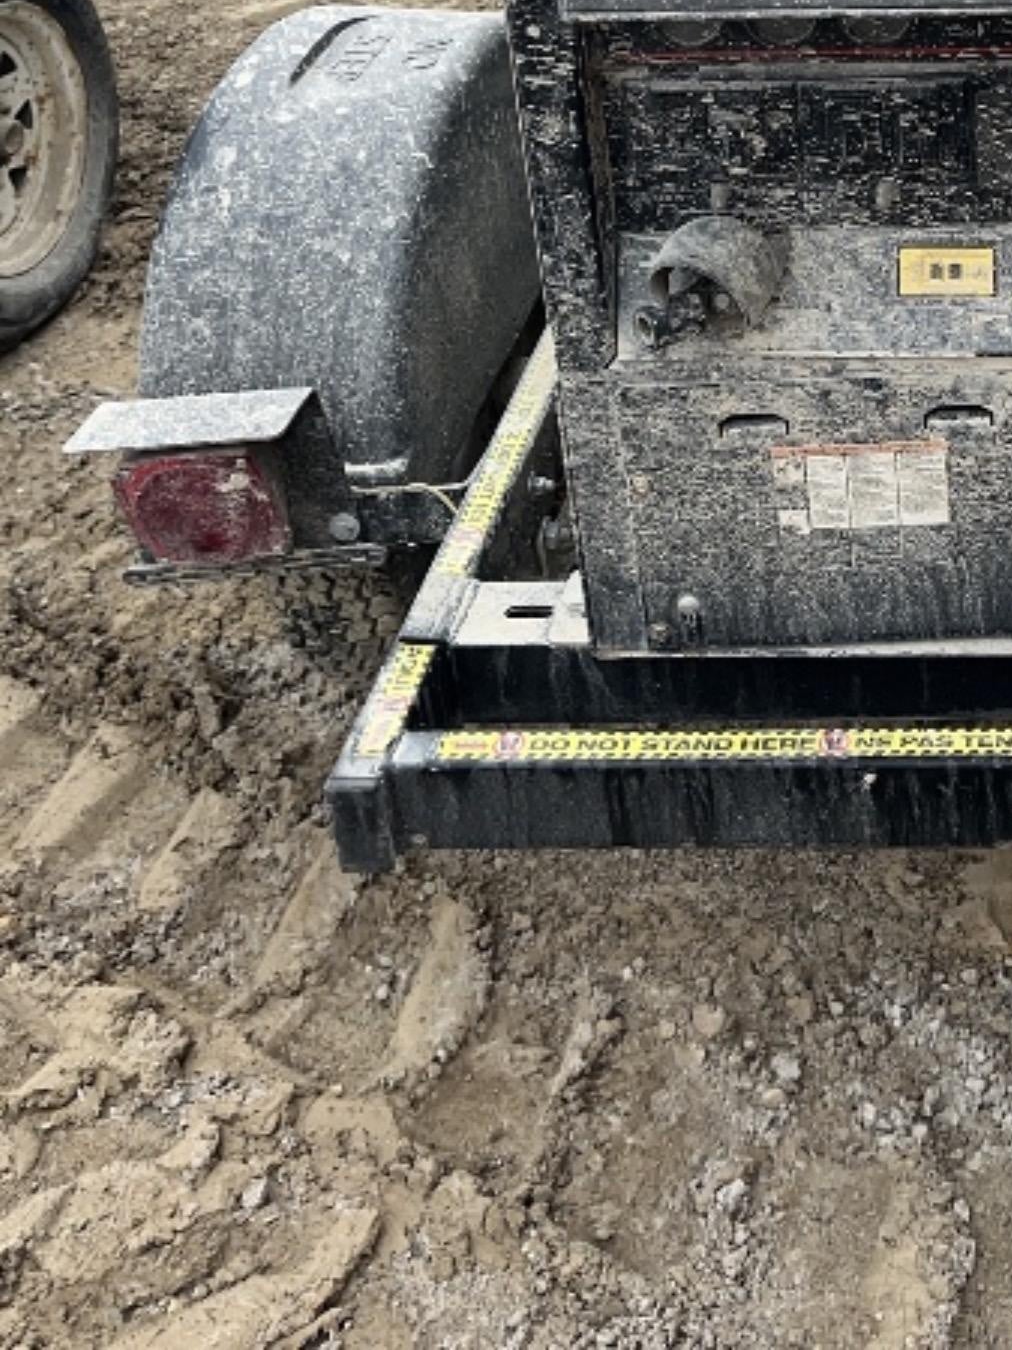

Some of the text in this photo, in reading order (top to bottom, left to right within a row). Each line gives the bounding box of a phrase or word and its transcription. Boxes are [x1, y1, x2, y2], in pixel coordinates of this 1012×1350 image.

[529, 736, 818, 750] DO NOT STAND HERE
